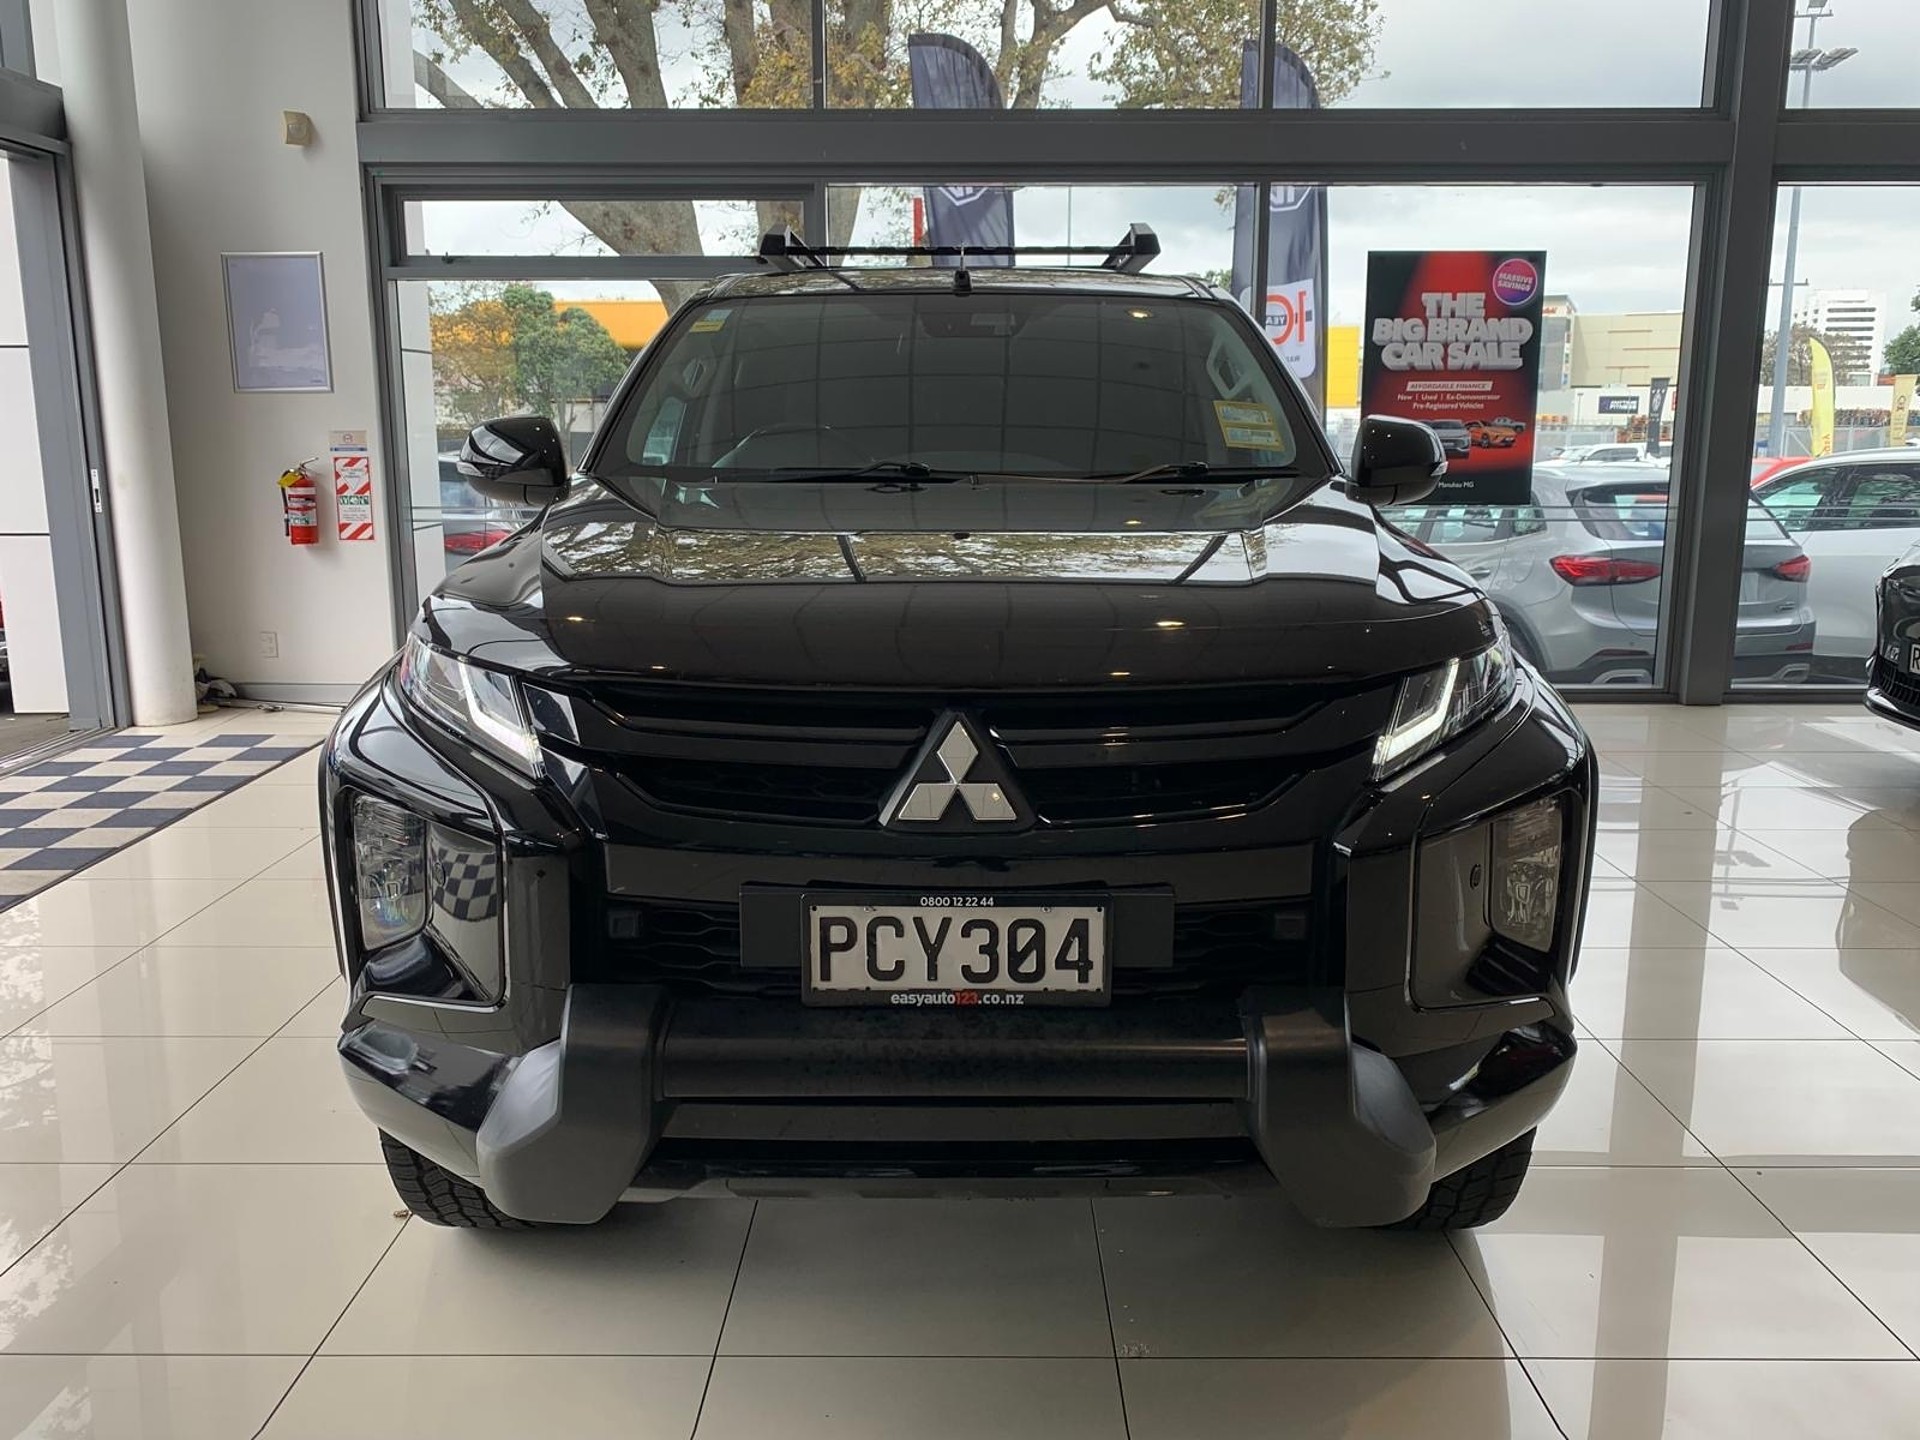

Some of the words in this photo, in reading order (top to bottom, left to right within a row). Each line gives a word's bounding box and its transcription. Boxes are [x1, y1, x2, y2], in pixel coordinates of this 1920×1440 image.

[1498, 272, 1533, 284] MASSIVE
[1497, 280, 1531, 291] SAVINGS
[1421, 292, 1486, 318] THE
[1372, 317, 1426, 346] BIG
[1427, 317, 1533, 345] BRAND
[1381, 342, 1444, 371] CAR
[1447, 341, 1523, 370] SALE
[1397, 393, 1413, 401] New
[1421, 393, 1438, 401] Used
[1412, 402, 1459, 411] Pre-Registered
[1459, 402, 1484, 410] Vehicles
[920, 897, 950, 907] 0800
[952, 897, 963, 907] 12
[964, 897, 979, 907] 22
[980, 897, 994, 907] 44
[818, 916, 1094, 984] PCY304
[891, 990, 1024, 1006] easyauto123.co.nz
